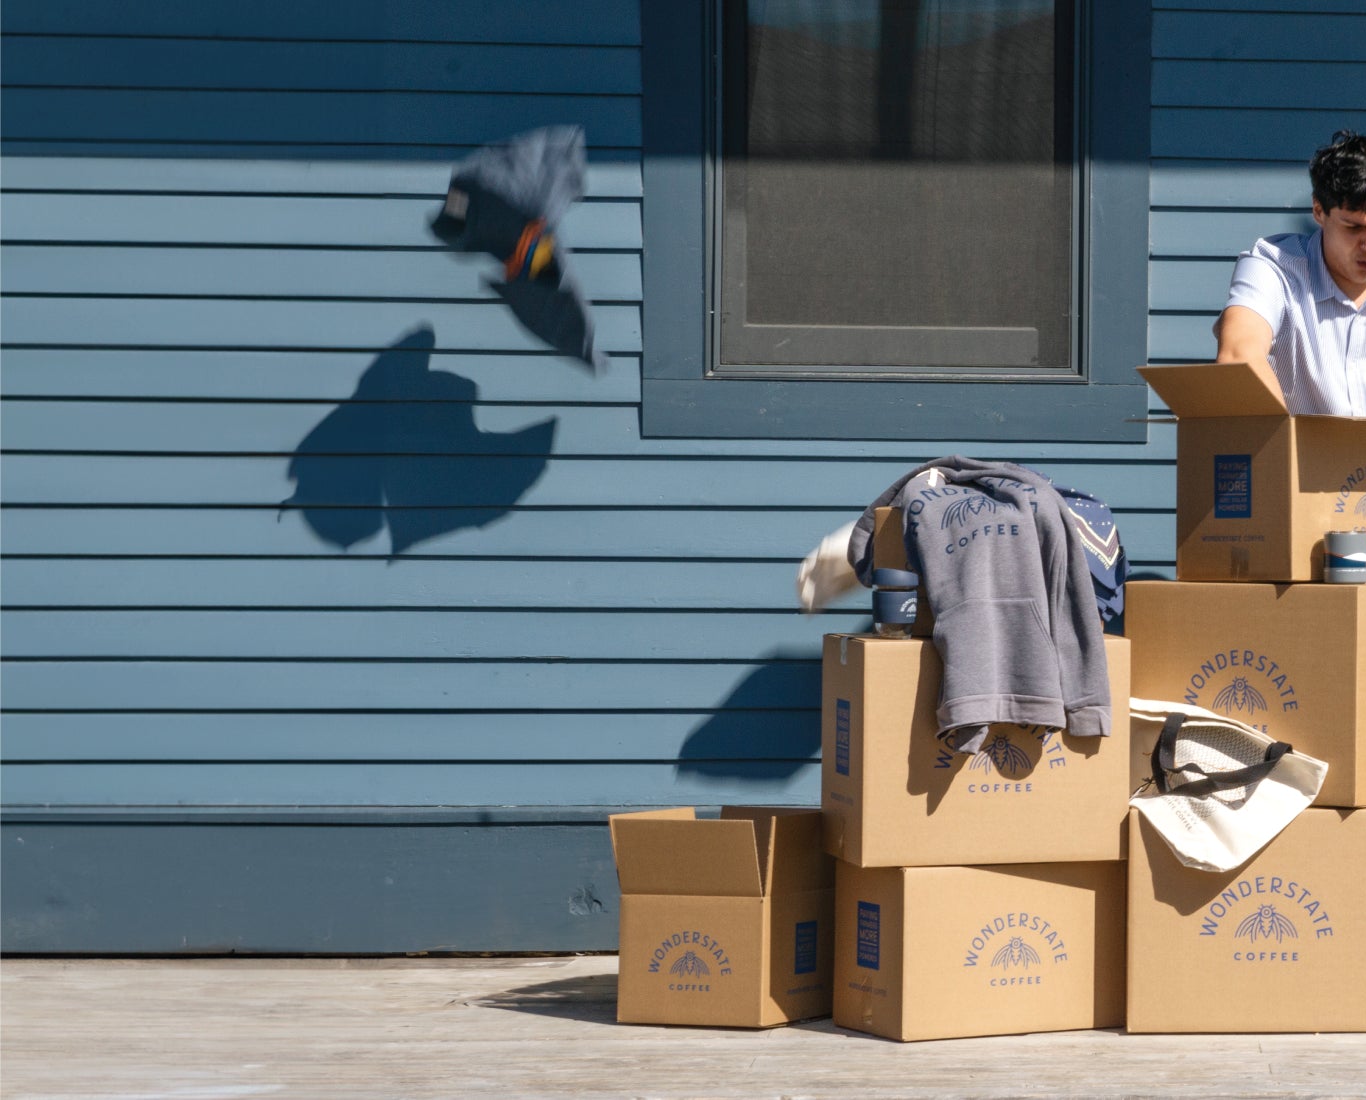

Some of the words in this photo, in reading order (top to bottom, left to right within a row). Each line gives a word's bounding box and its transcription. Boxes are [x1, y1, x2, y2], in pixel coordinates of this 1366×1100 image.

[1218, 480, 1248, 493] MORE
[945, 524, 1019, 554] COFFEE
[1184, 649, 1299, 712] WONDERSTATE
[968, 783, 1033, 793] COFFEE
[1199, 876, 1334, 940] WONDERSTATE
[963, 913, 1068, 968] WONDERSTATE
[648, 931, 732, 976] WONDERSTATE
[1234, 952, 1299, 961] COFFEE
[668, 984, 711, 993] COFFEE
[990, 976, 1042, 986] COFFEE
